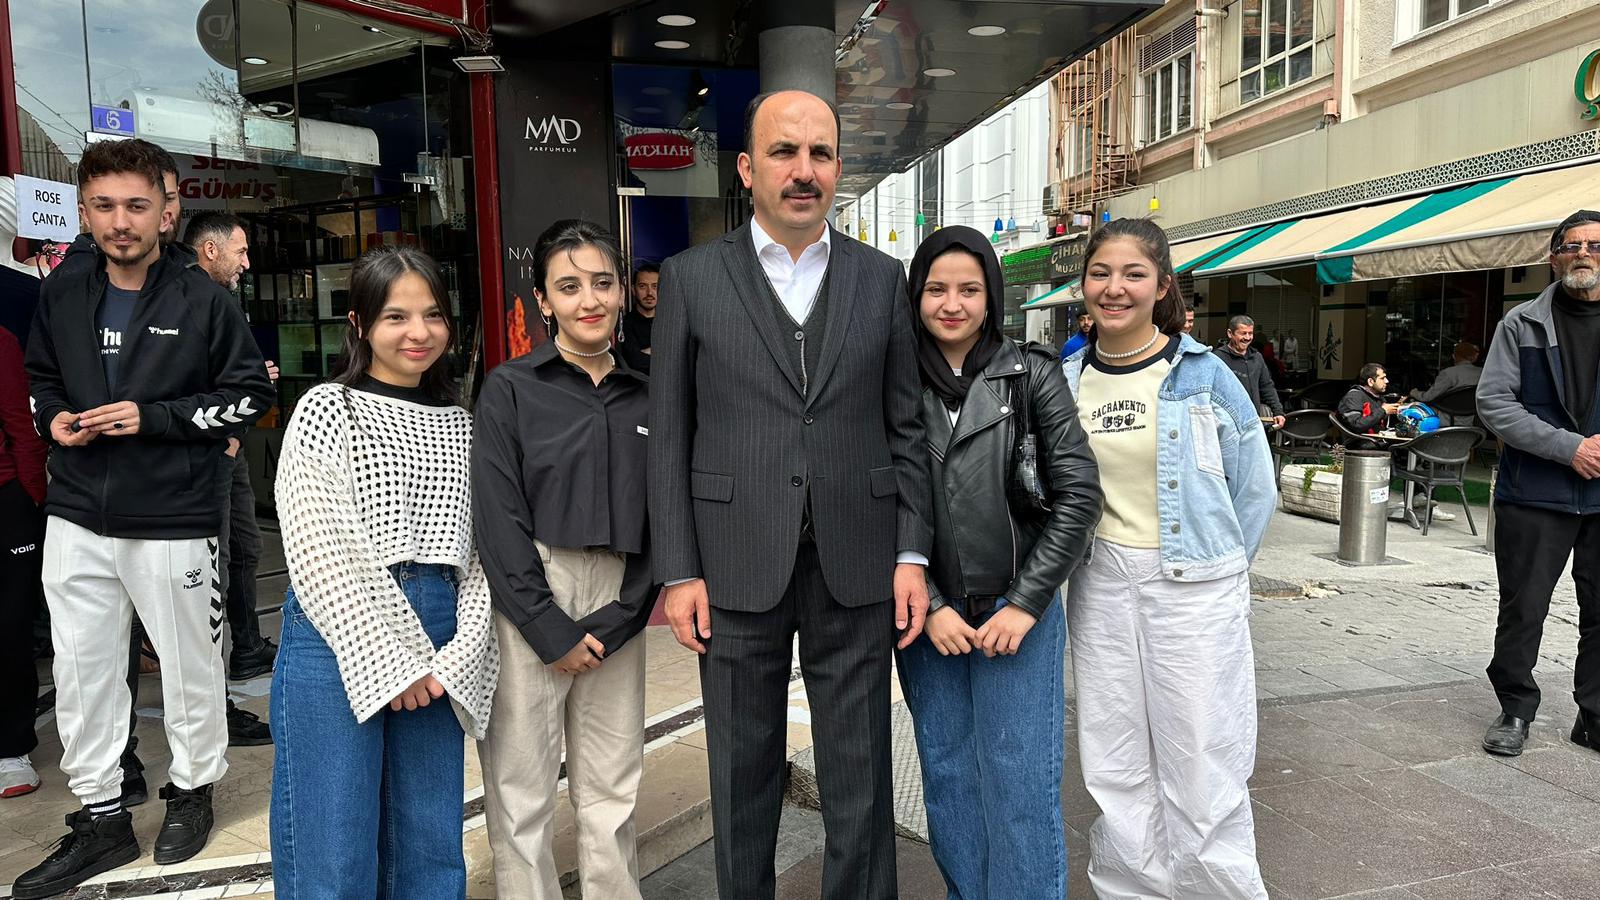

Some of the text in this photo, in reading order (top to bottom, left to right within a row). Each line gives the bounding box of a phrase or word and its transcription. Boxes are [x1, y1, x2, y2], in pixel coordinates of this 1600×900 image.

[524, 114, 582, 144] MAD
[35, 189, 61, 205] ROSE
[32, 211, 67, 227] ÇANTA
[509, 247, 533, 260] NA
[103, 327, 122, 346] hu
[1091, 399, 1146, 421] SACRAMENTO
[10, 543, 35, 555] VOID
